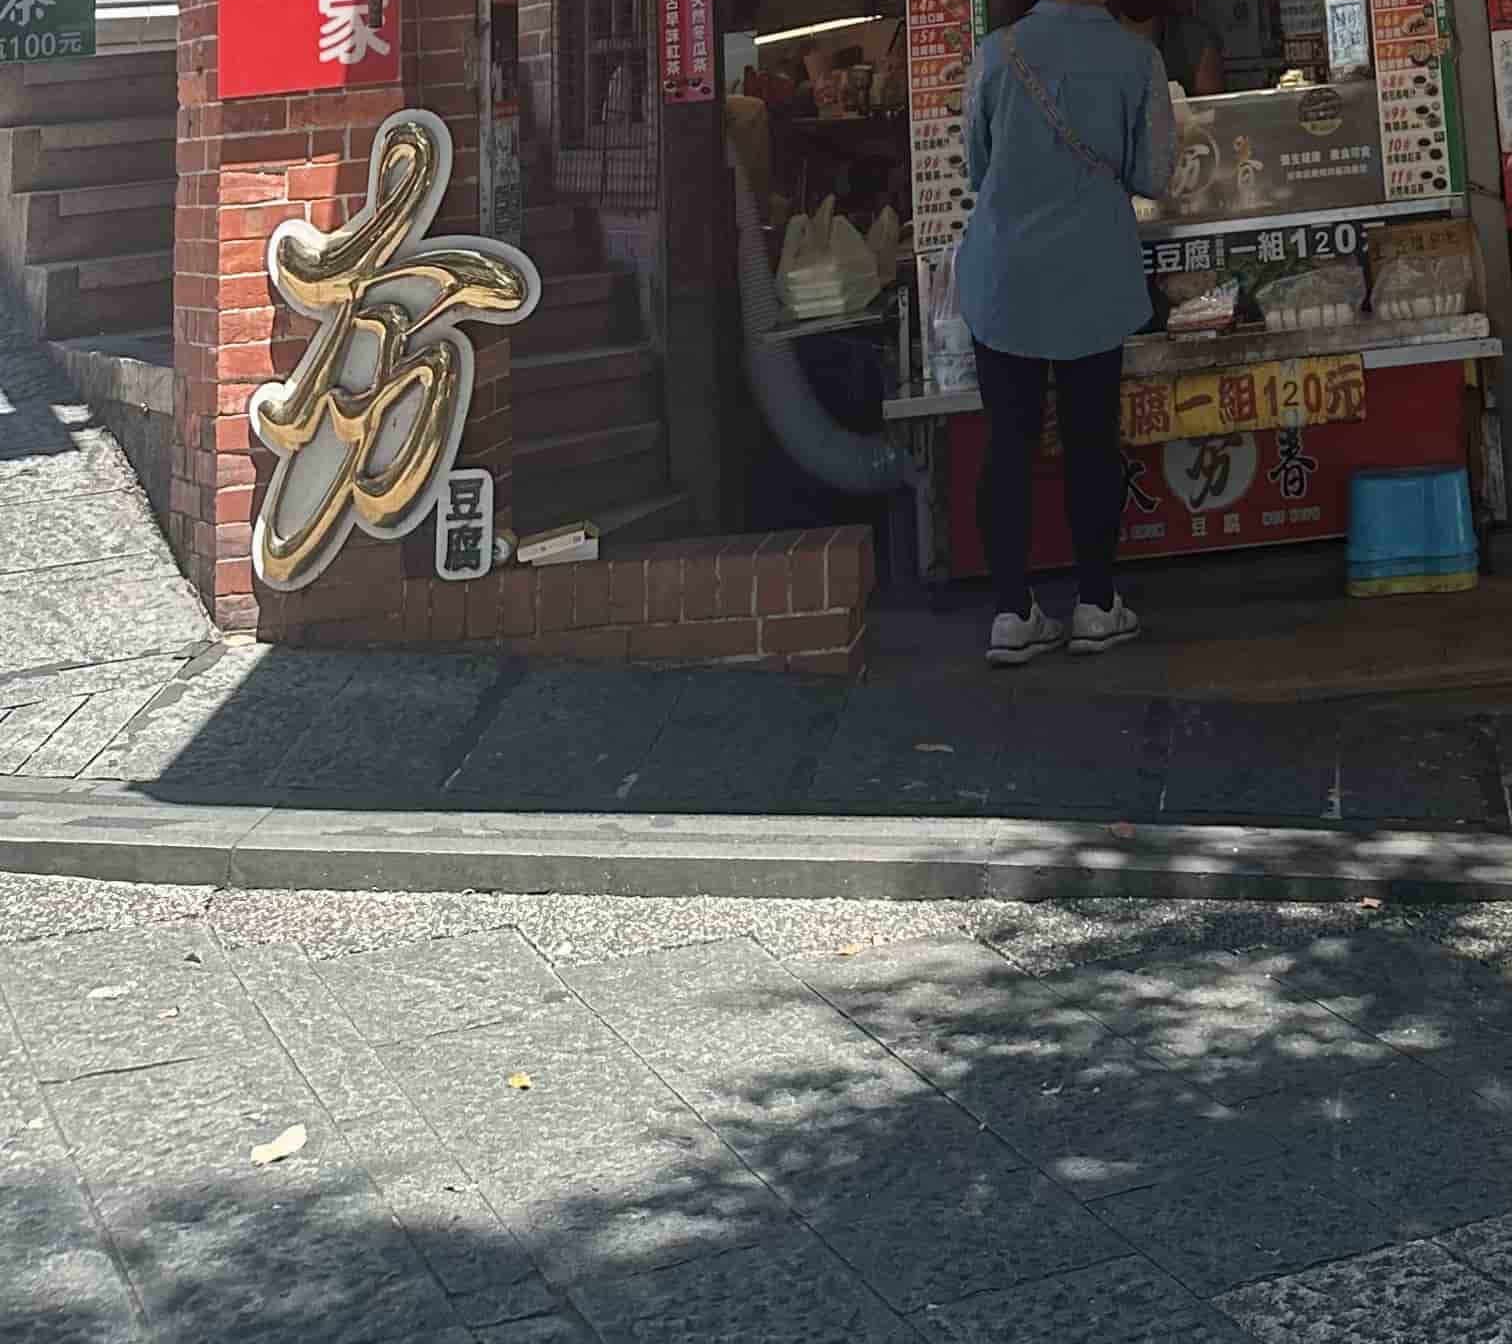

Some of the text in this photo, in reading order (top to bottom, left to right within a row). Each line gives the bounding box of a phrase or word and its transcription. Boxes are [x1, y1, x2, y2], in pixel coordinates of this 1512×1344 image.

[1230, 222, 1367, 262] 一組120
[1120, 362, 1366, 437] 腐一組120元
